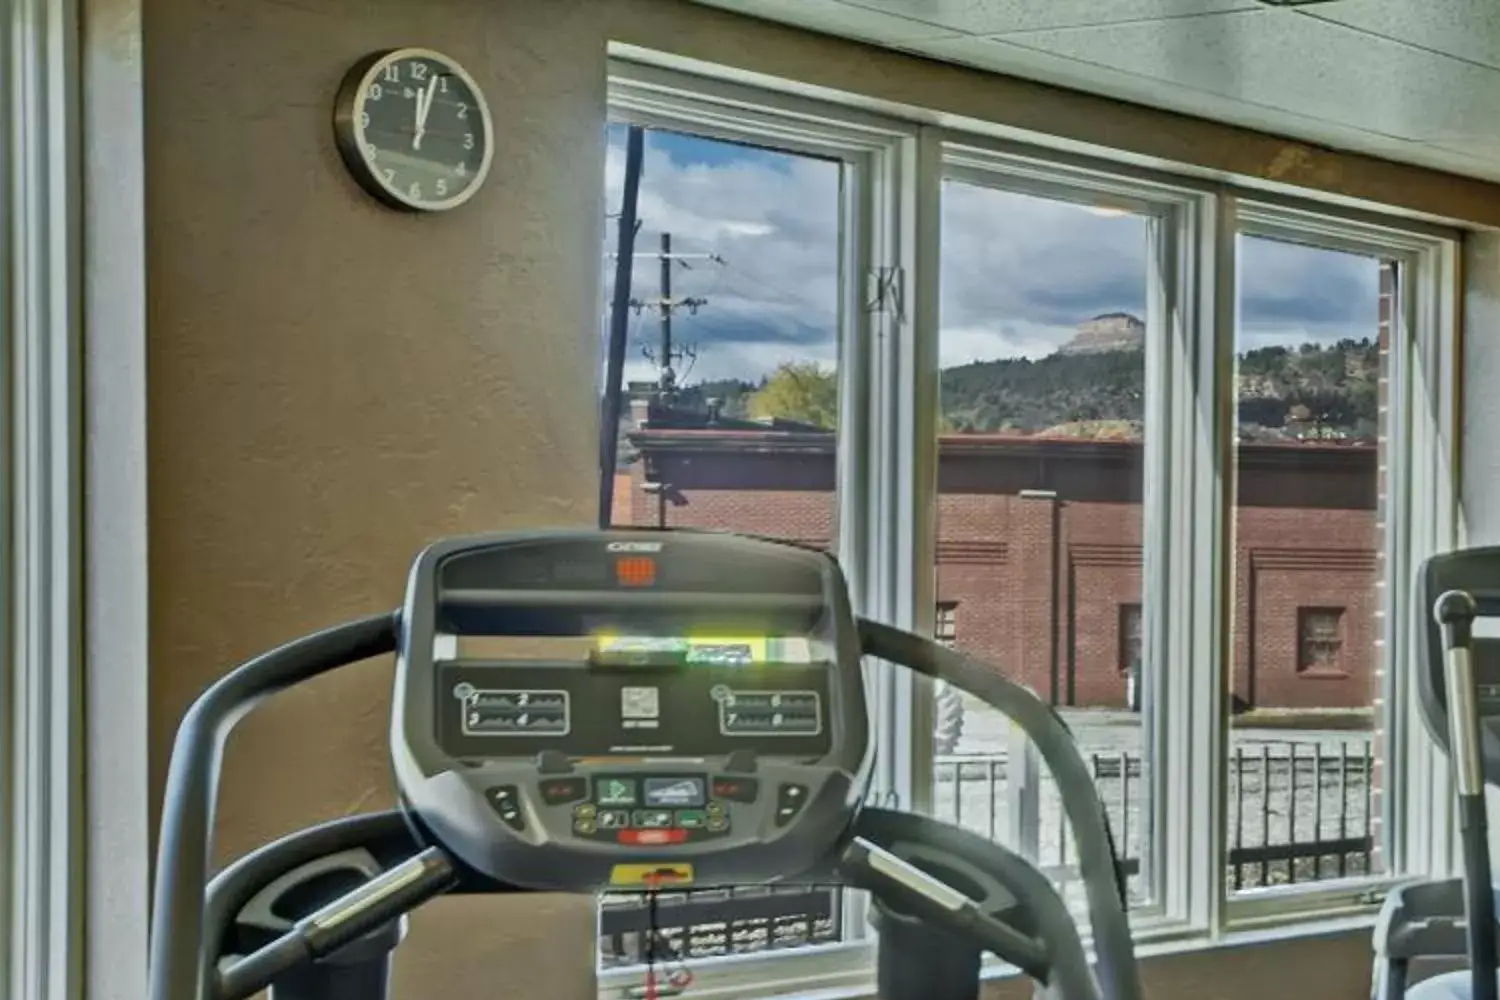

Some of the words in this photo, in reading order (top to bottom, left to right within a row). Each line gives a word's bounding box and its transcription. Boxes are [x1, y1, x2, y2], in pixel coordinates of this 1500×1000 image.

[383, 65, 400, 82] 11
[410, 62, 428, 80] 12
[440, 77, 448, 93] 1
[456, 103, 468, 119] 2
[463, 133, 474, 150] 3
[366, 144, 377, 161] 8
[384, 168, 397, 184] 7
[455, 161, 466, 177] 4
[408, 181, 421, 199] 6
[436, 179, 447, 195] 5
